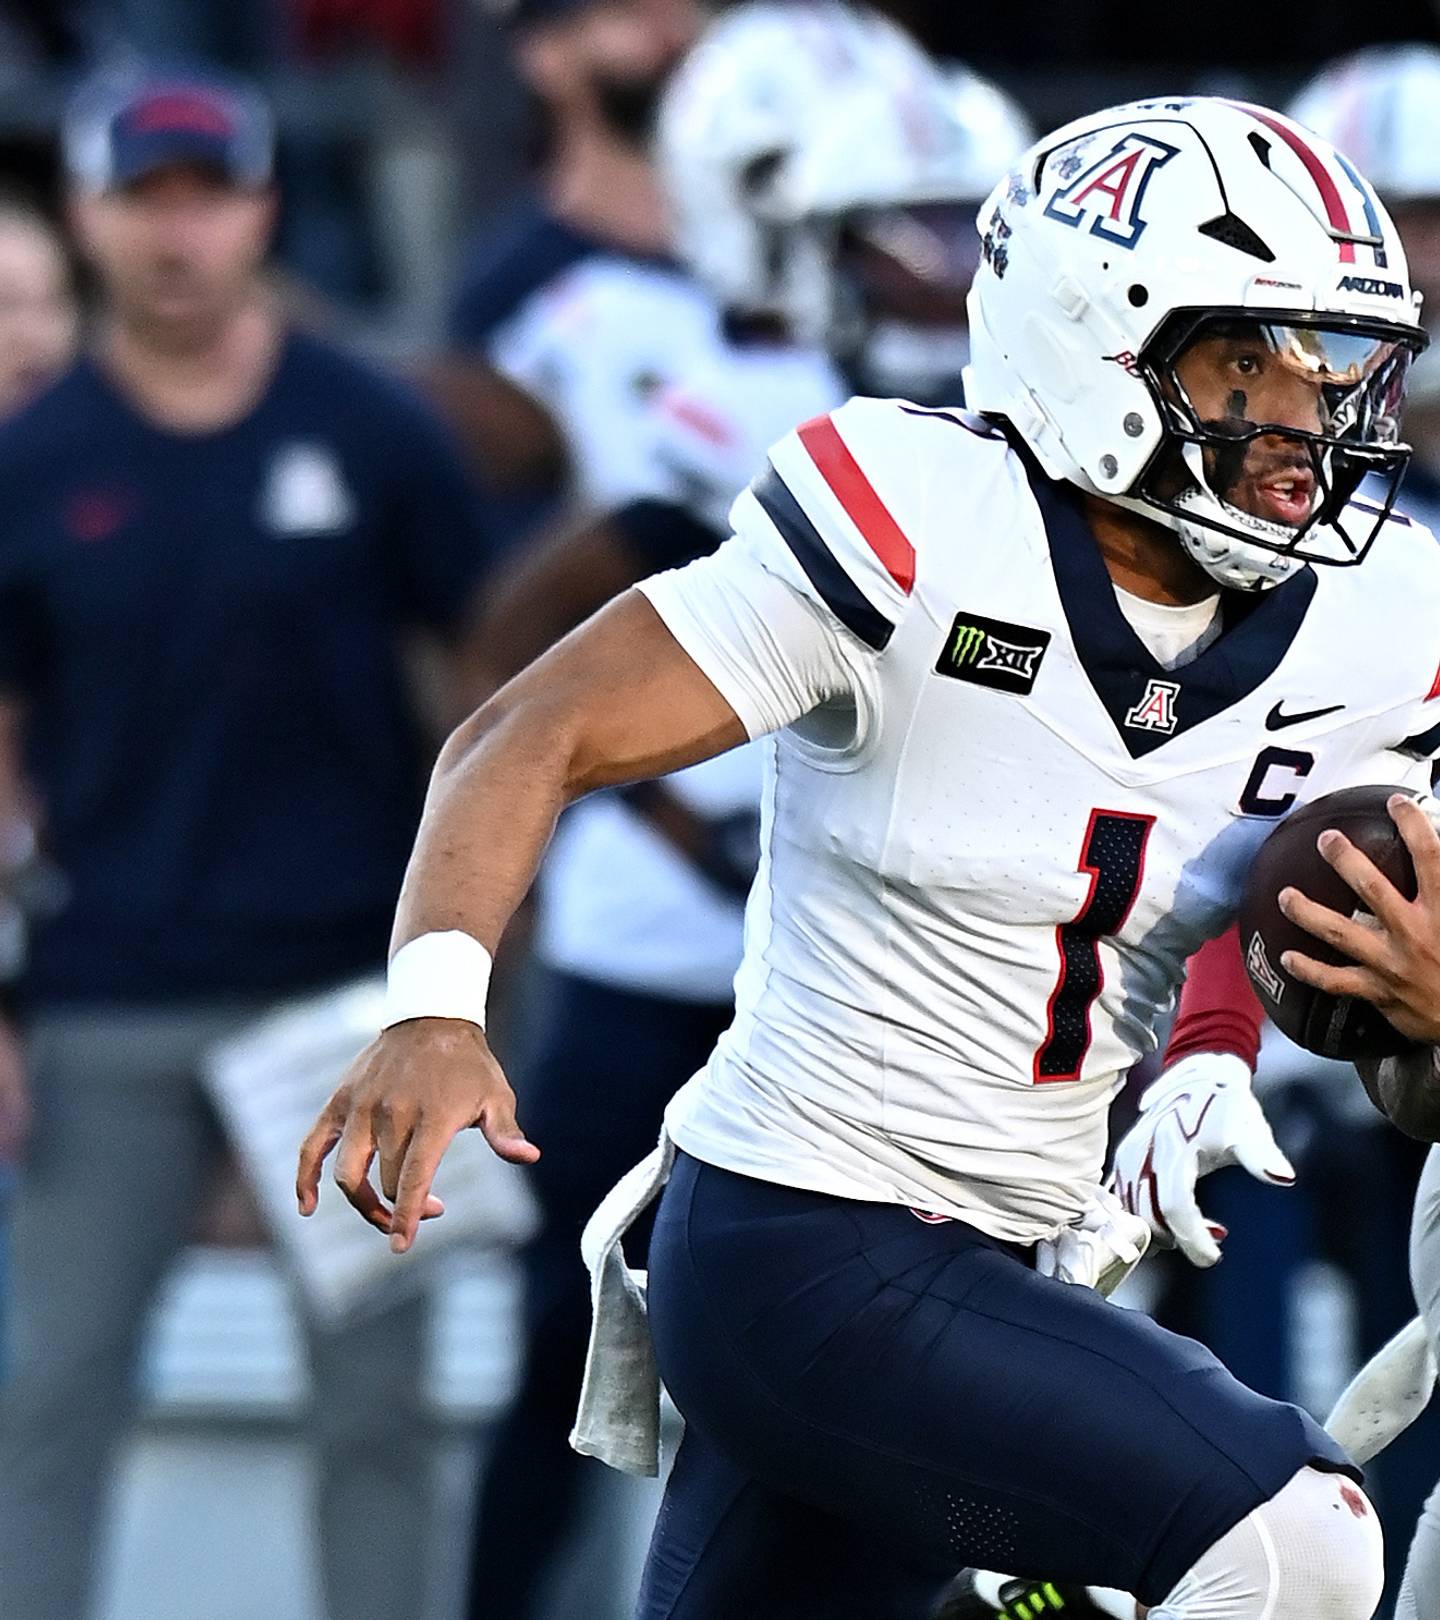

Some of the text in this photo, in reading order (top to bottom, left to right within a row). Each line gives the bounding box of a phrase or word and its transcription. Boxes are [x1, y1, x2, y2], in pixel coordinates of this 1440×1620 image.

[1043, 133, 1182, 250] A
[1125, 679, 1182, 735] A
[1236, 746, 1316, 816] C
[1034, 808, 1157, 1084] 1
